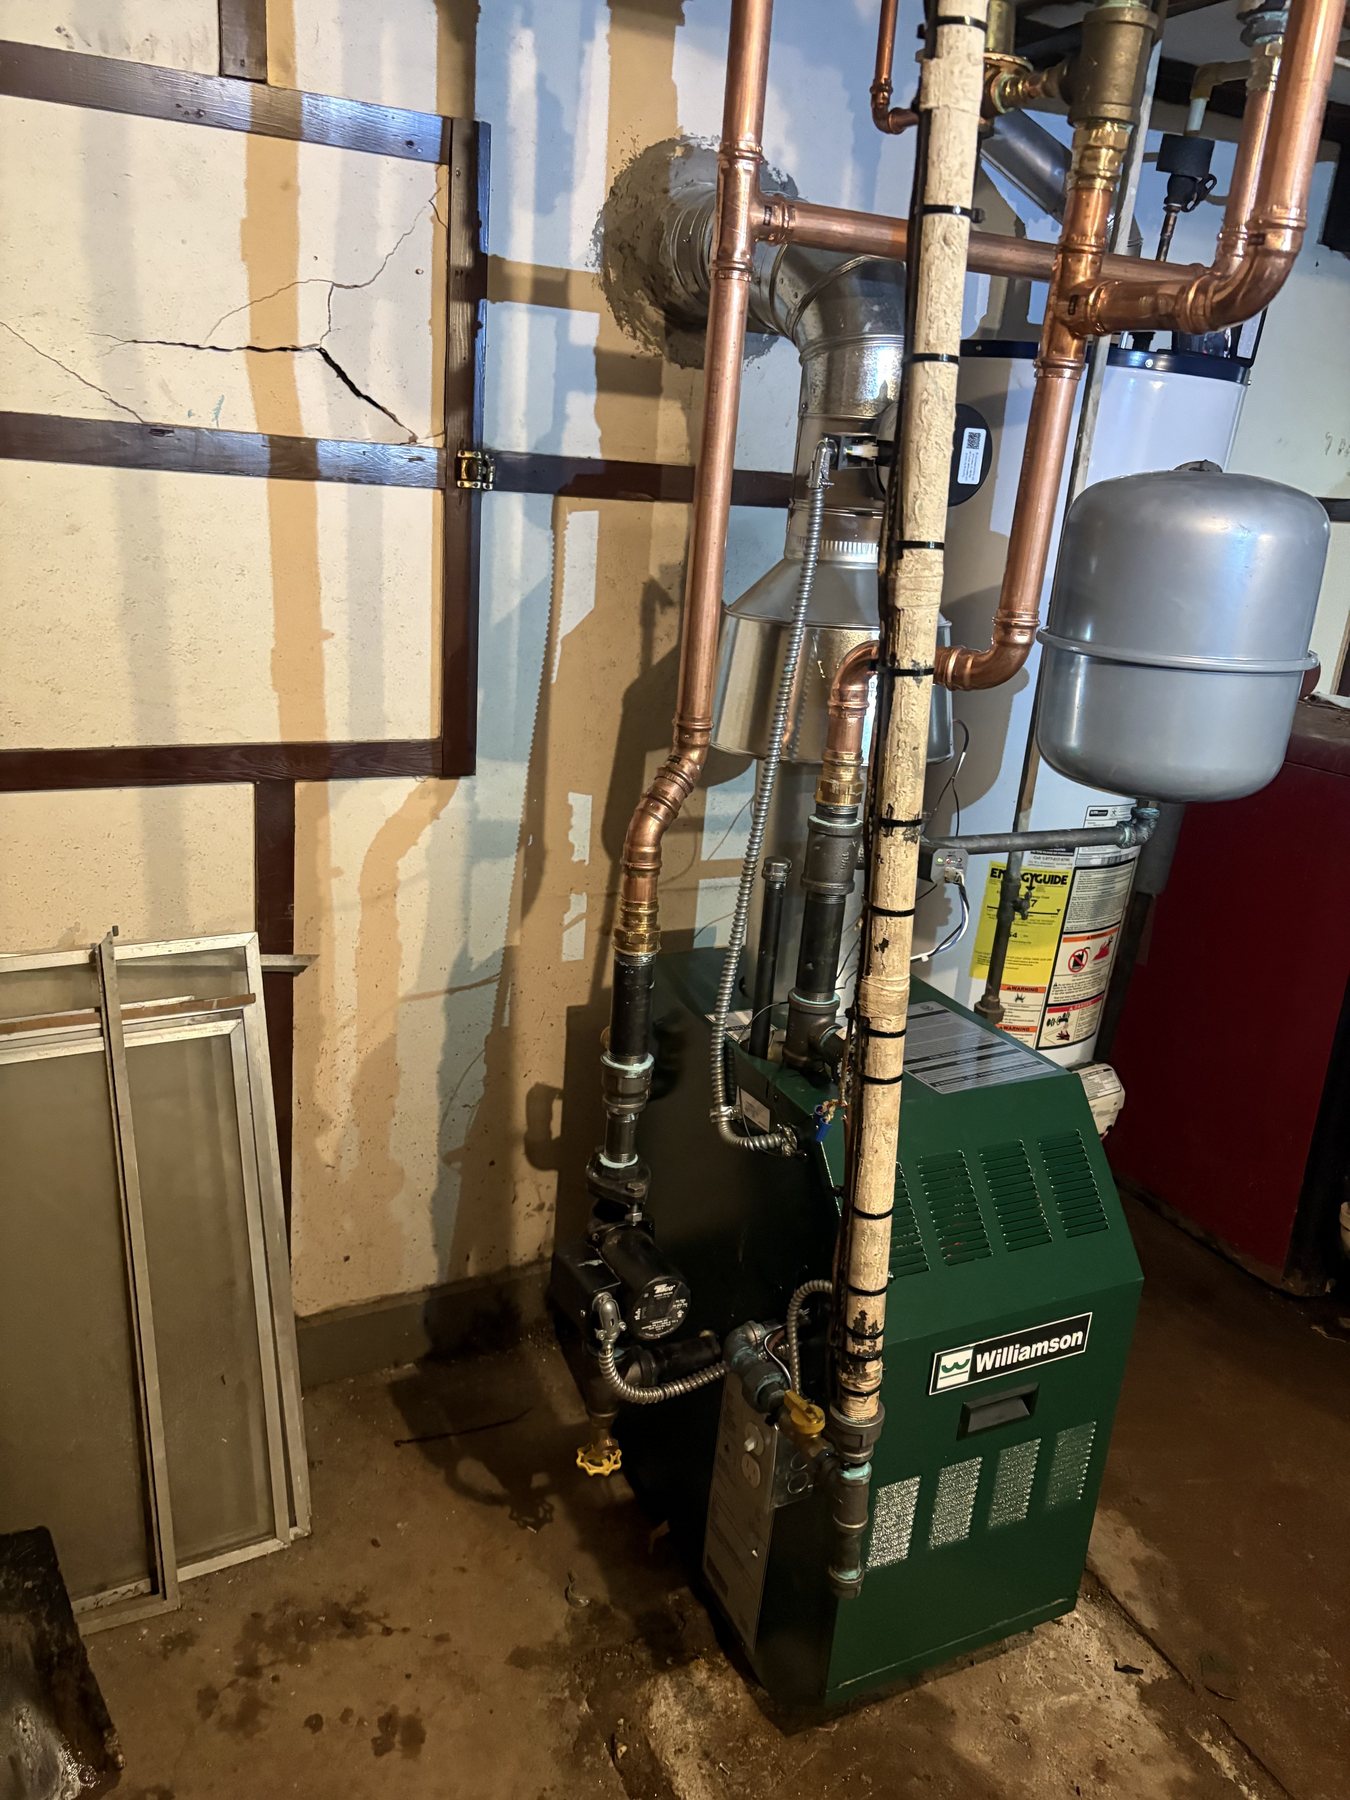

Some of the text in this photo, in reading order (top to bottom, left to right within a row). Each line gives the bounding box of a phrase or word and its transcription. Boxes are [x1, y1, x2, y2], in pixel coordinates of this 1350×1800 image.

[990, 867, 1069, 886] ENGYGUIDE
[1003, 1025, 1030, 1033] WARNING
[975, 1330, 1084, 1374] Williamson
